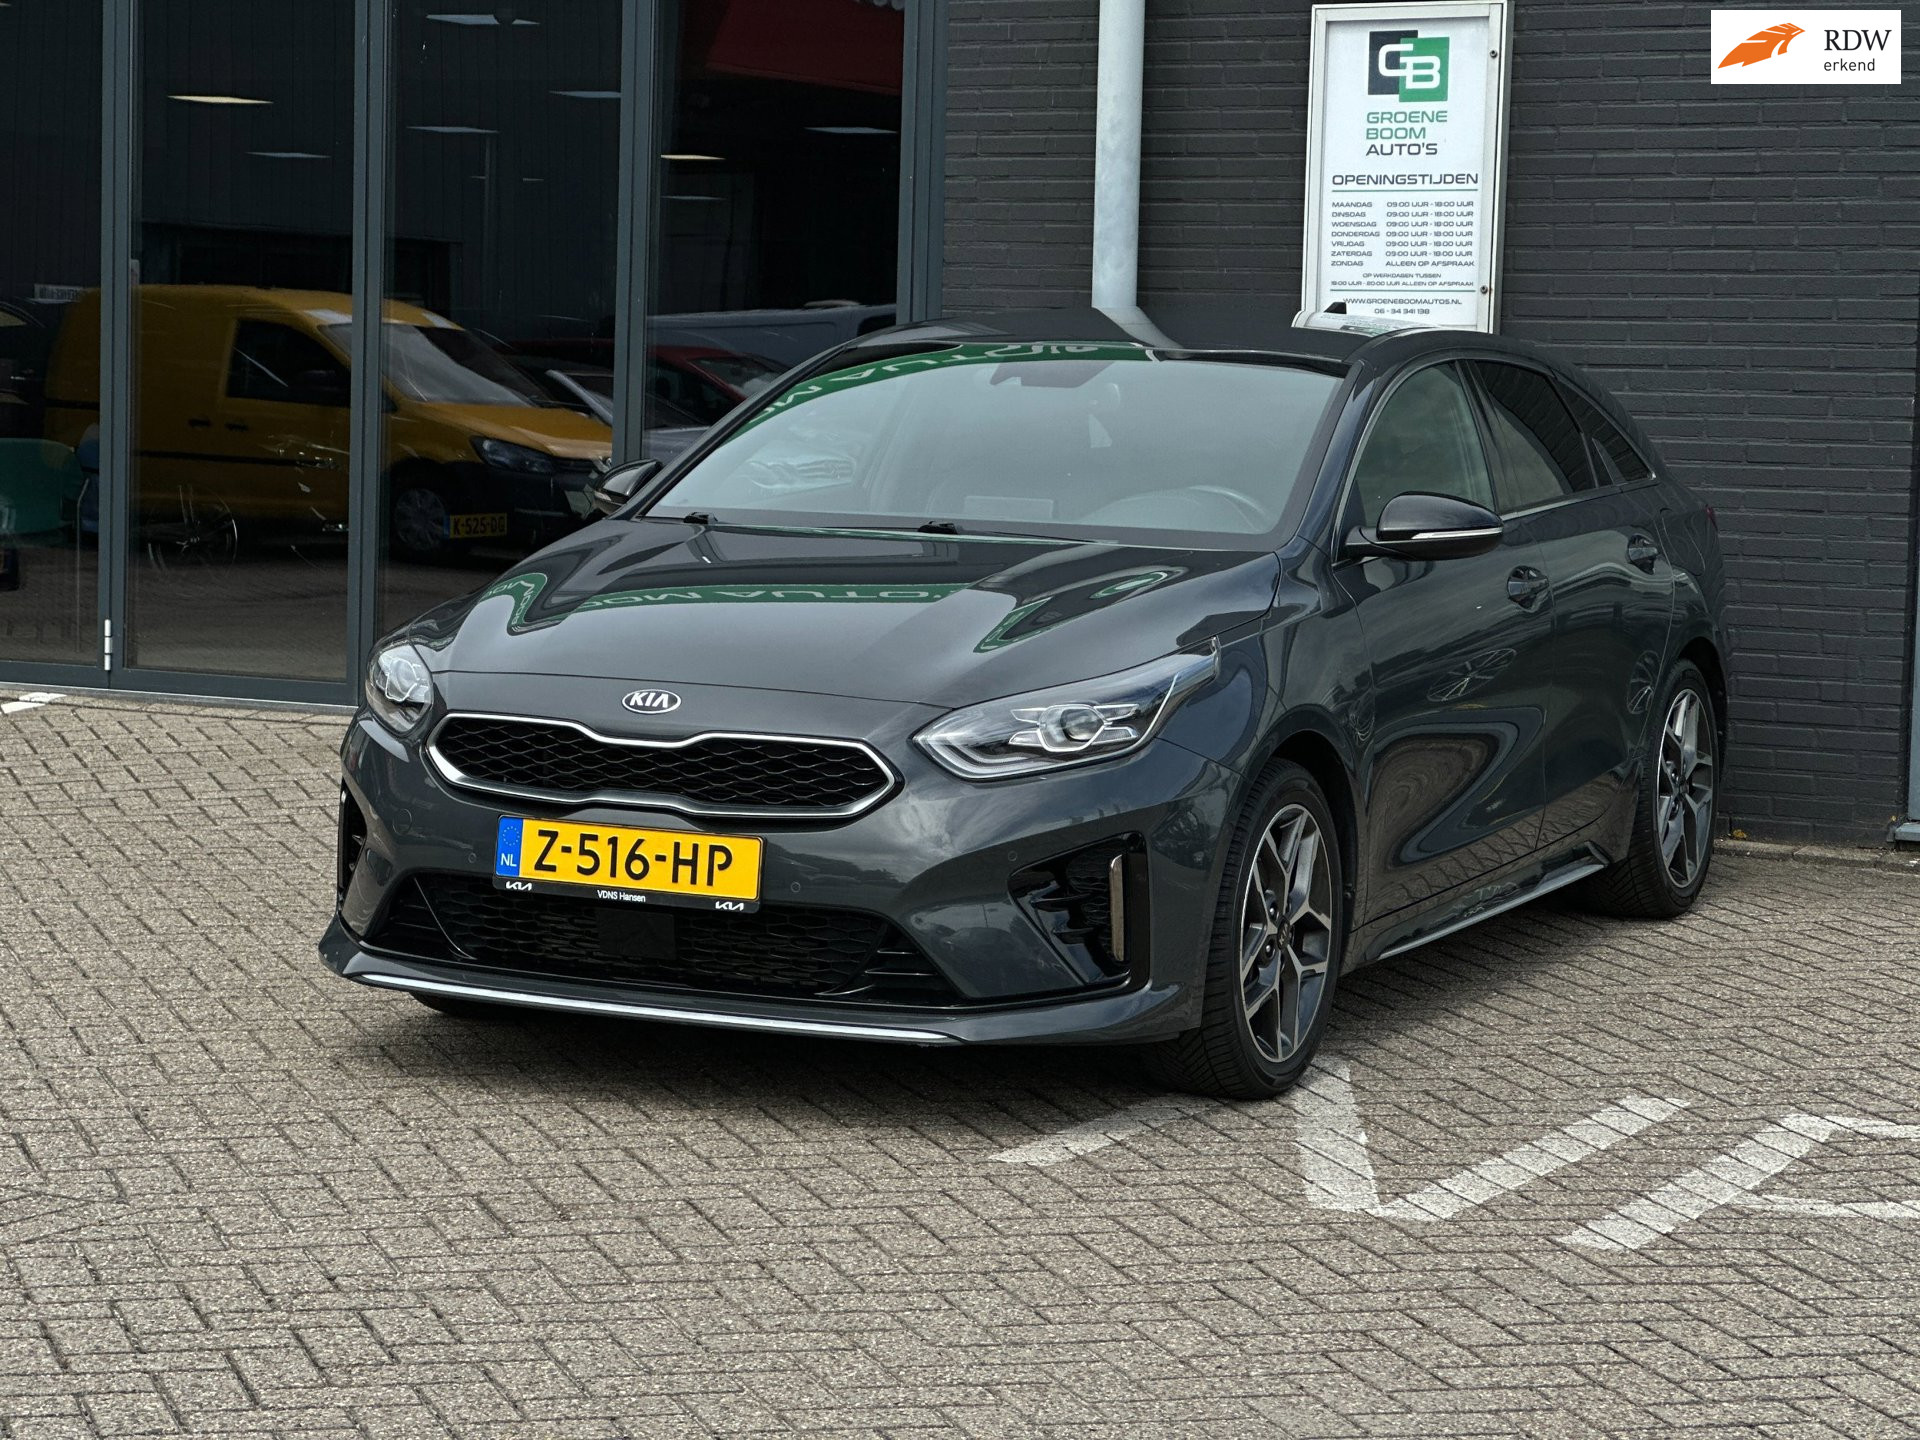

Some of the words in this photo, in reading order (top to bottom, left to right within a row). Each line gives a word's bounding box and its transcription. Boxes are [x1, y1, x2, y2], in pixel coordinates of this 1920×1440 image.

[1366, 110, 1448, 124] GROENE
[1366, 127, 1426, 140] BOOM
[1366, 143, 1438, 156] AUTO'S
[1332, 173, 1479, 186] OPENINGSTIJDEN
[629, 692, 670, 709] KIA
[500, 854, 517, 867] NL
[533, 829, 733, 887] Z-516-HP
[597, 890, 618, 900] VDNS
[619, 891, 646, 903] Hansen
